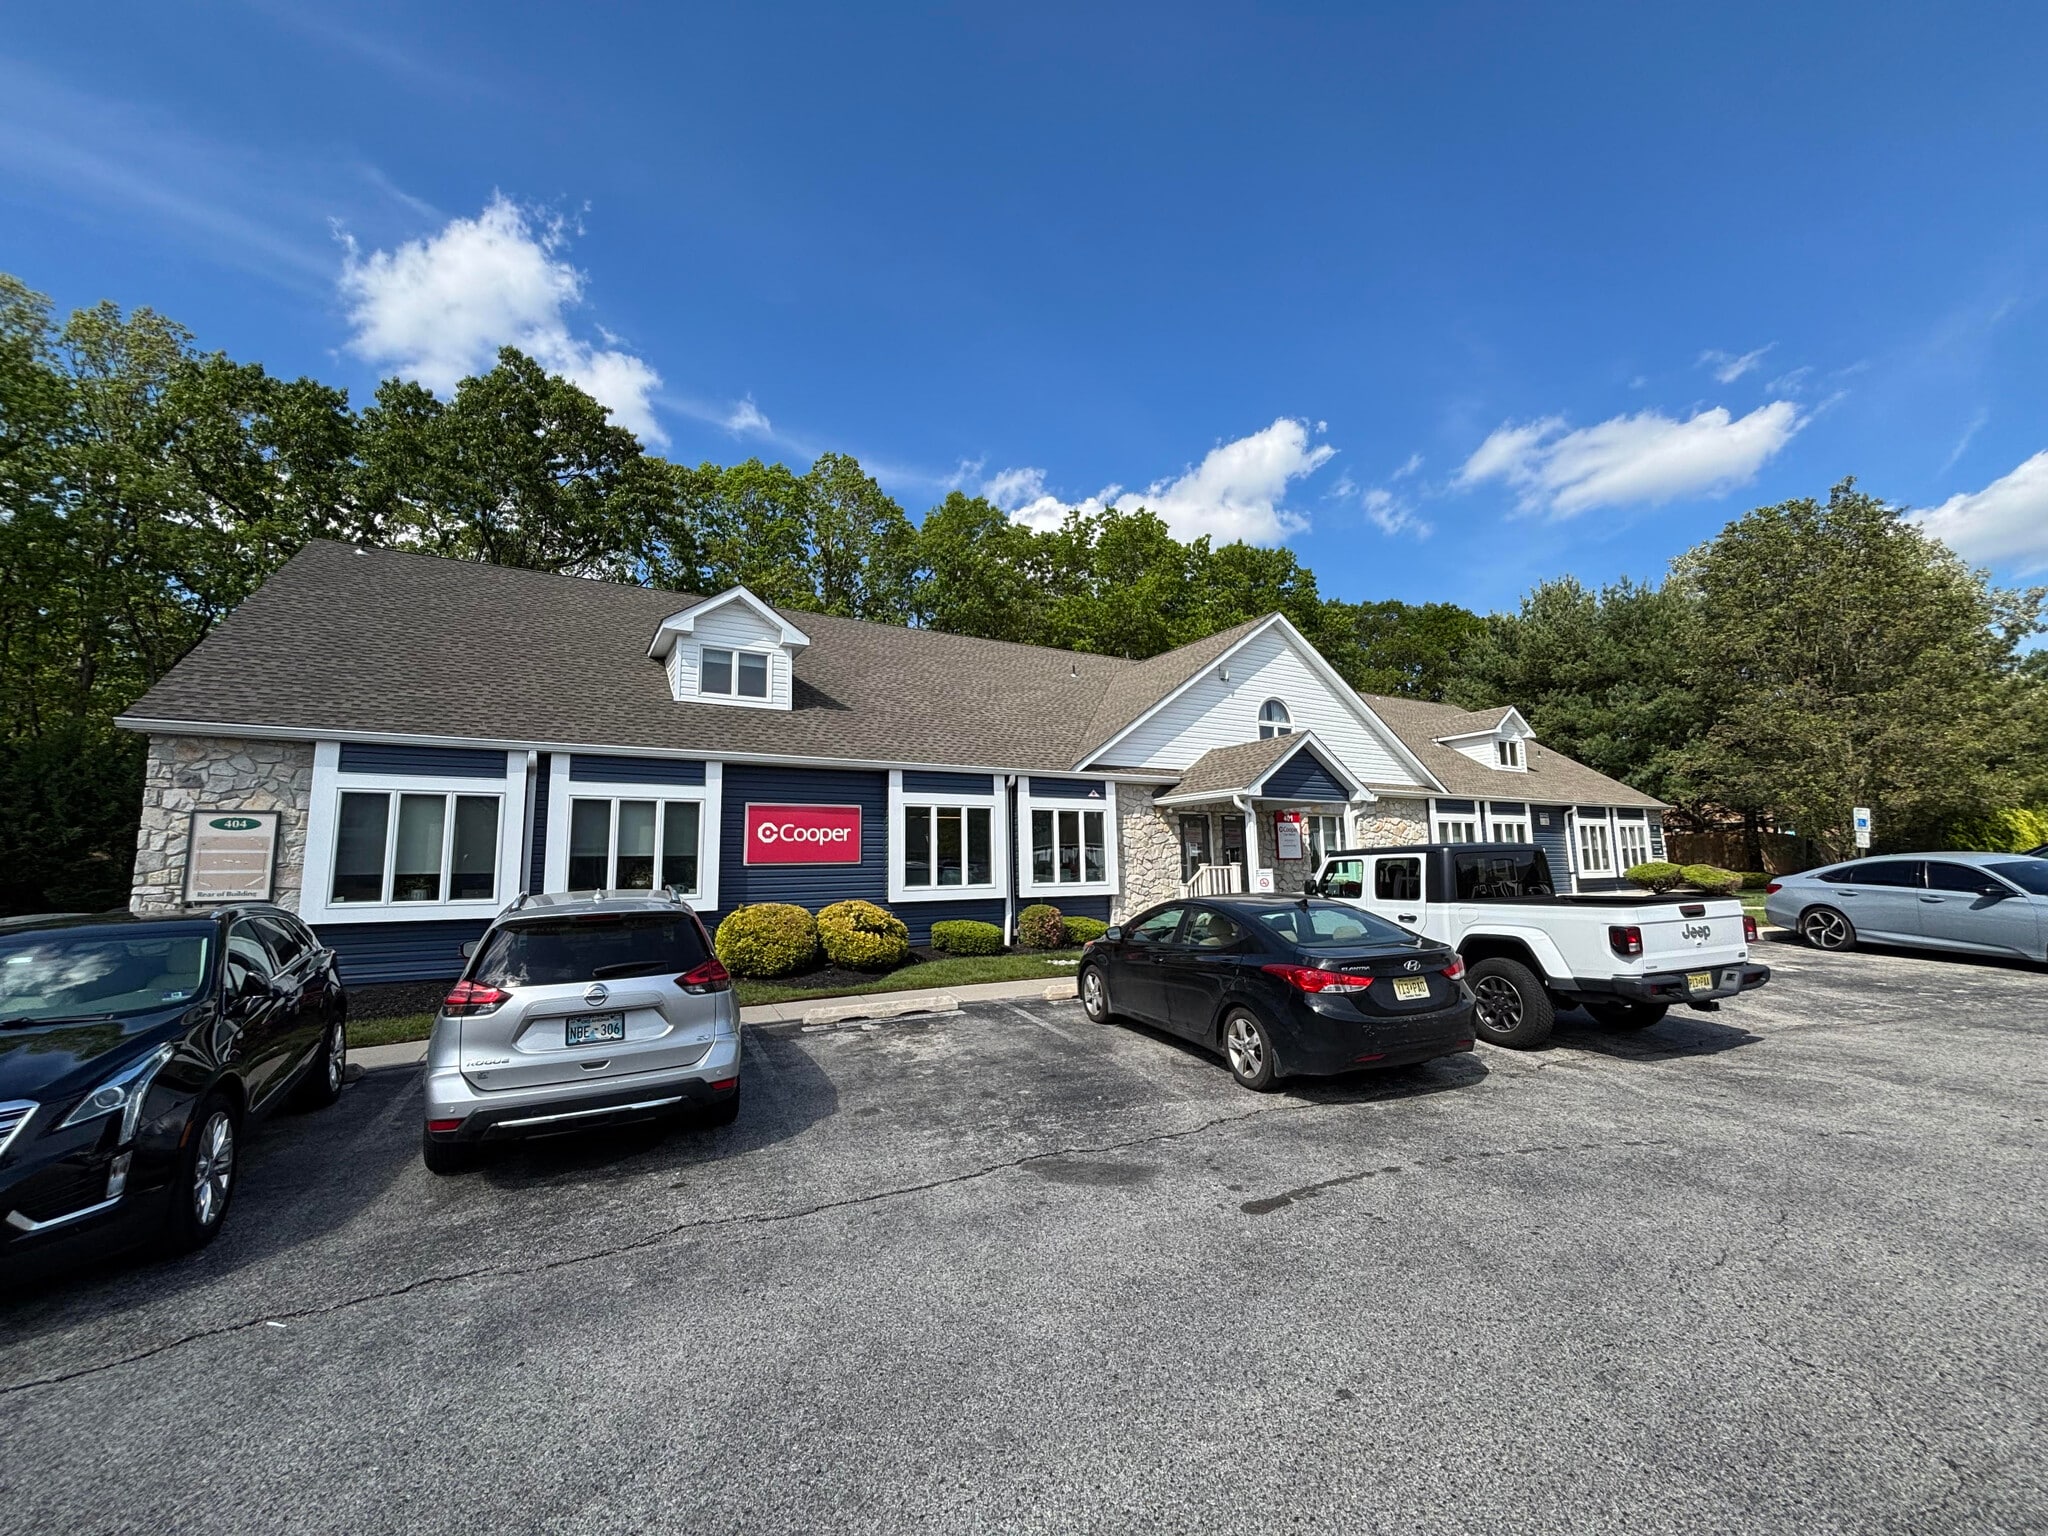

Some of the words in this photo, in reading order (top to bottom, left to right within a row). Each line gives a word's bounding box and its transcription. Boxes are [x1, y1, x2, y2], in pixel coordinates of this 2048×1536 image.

[223, 820, 247, 828] 404
[780, 824, 852, 846] Cooper
[226, 890, 257, 898] Building
[1682, 923, 1711, 940] Jeep
[570, 1025, 591, 1040] NBE
[600, 1022, 620, 1036] 306
